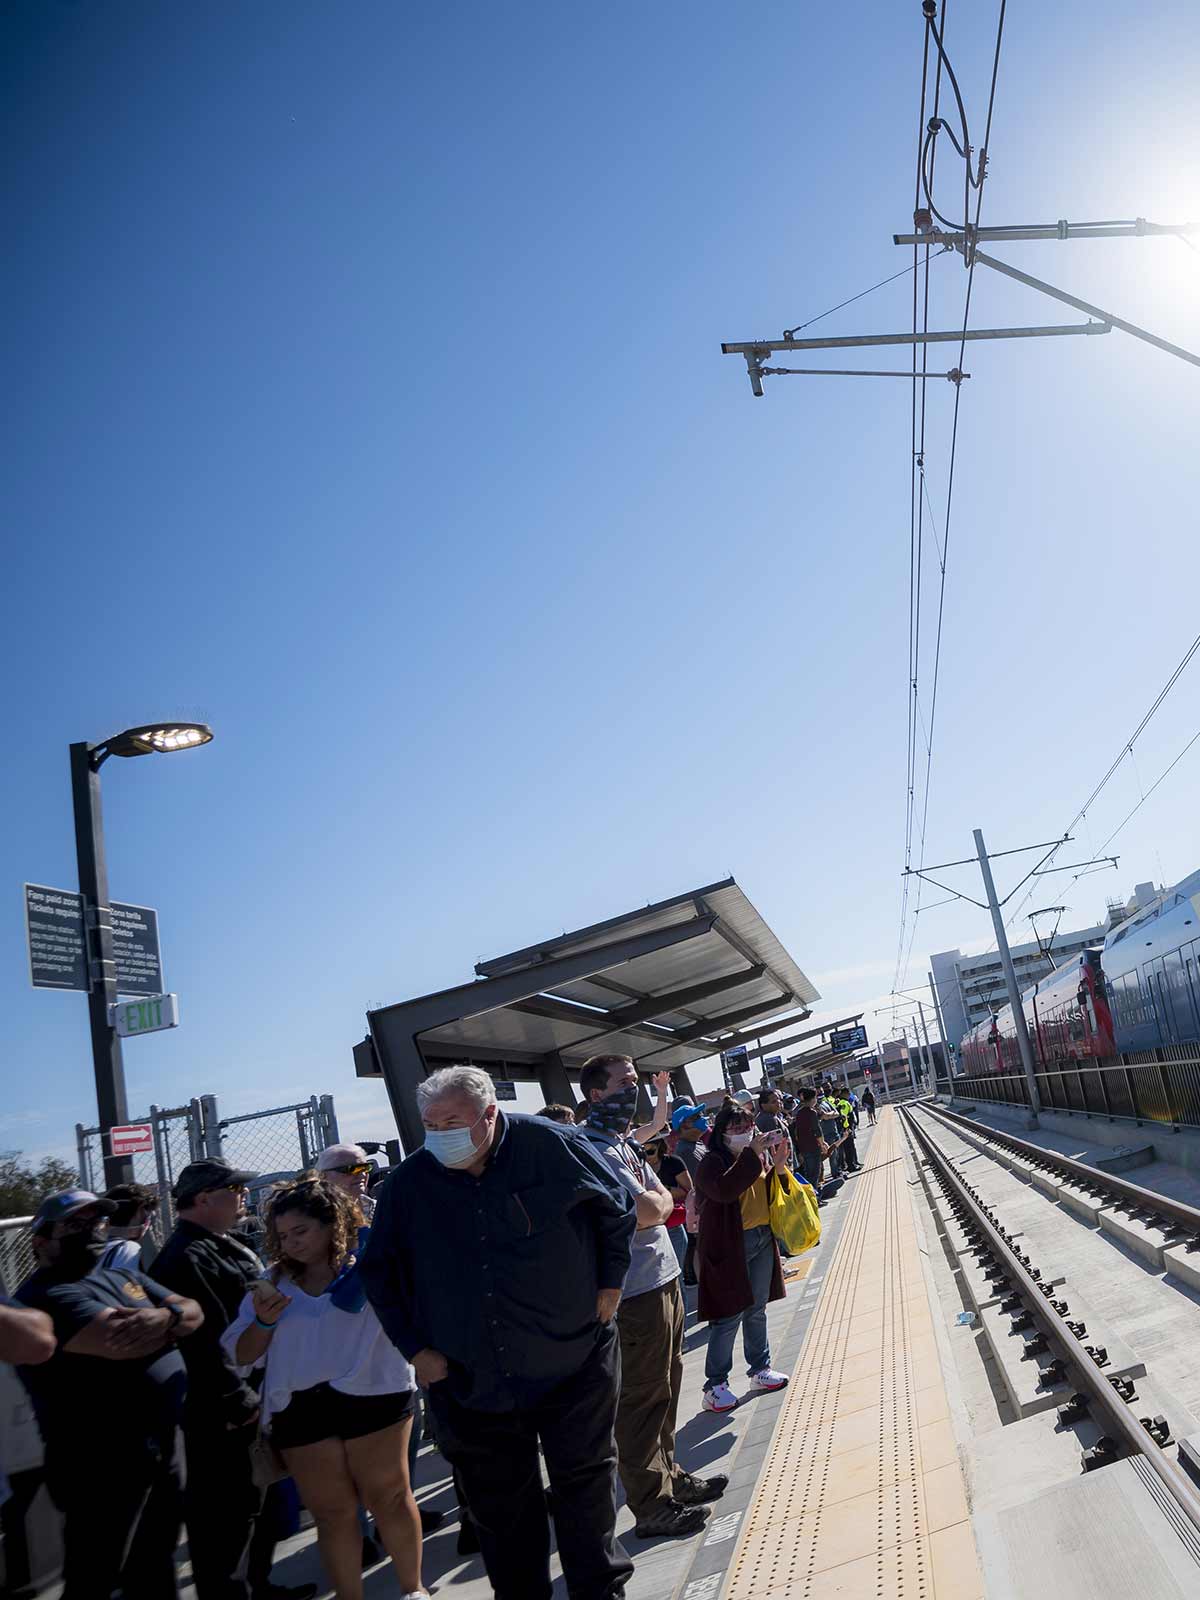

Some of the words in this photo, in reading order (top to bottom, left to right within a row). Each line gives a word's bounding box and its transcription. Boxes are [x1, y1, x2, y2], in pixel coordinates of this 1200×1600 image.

[28, 889, 45, 901] Fare
[45, 895, 62, 904] paid
[28, 901, 54, 914] Tickets
[127, 999, 162, 1031] EXIT
